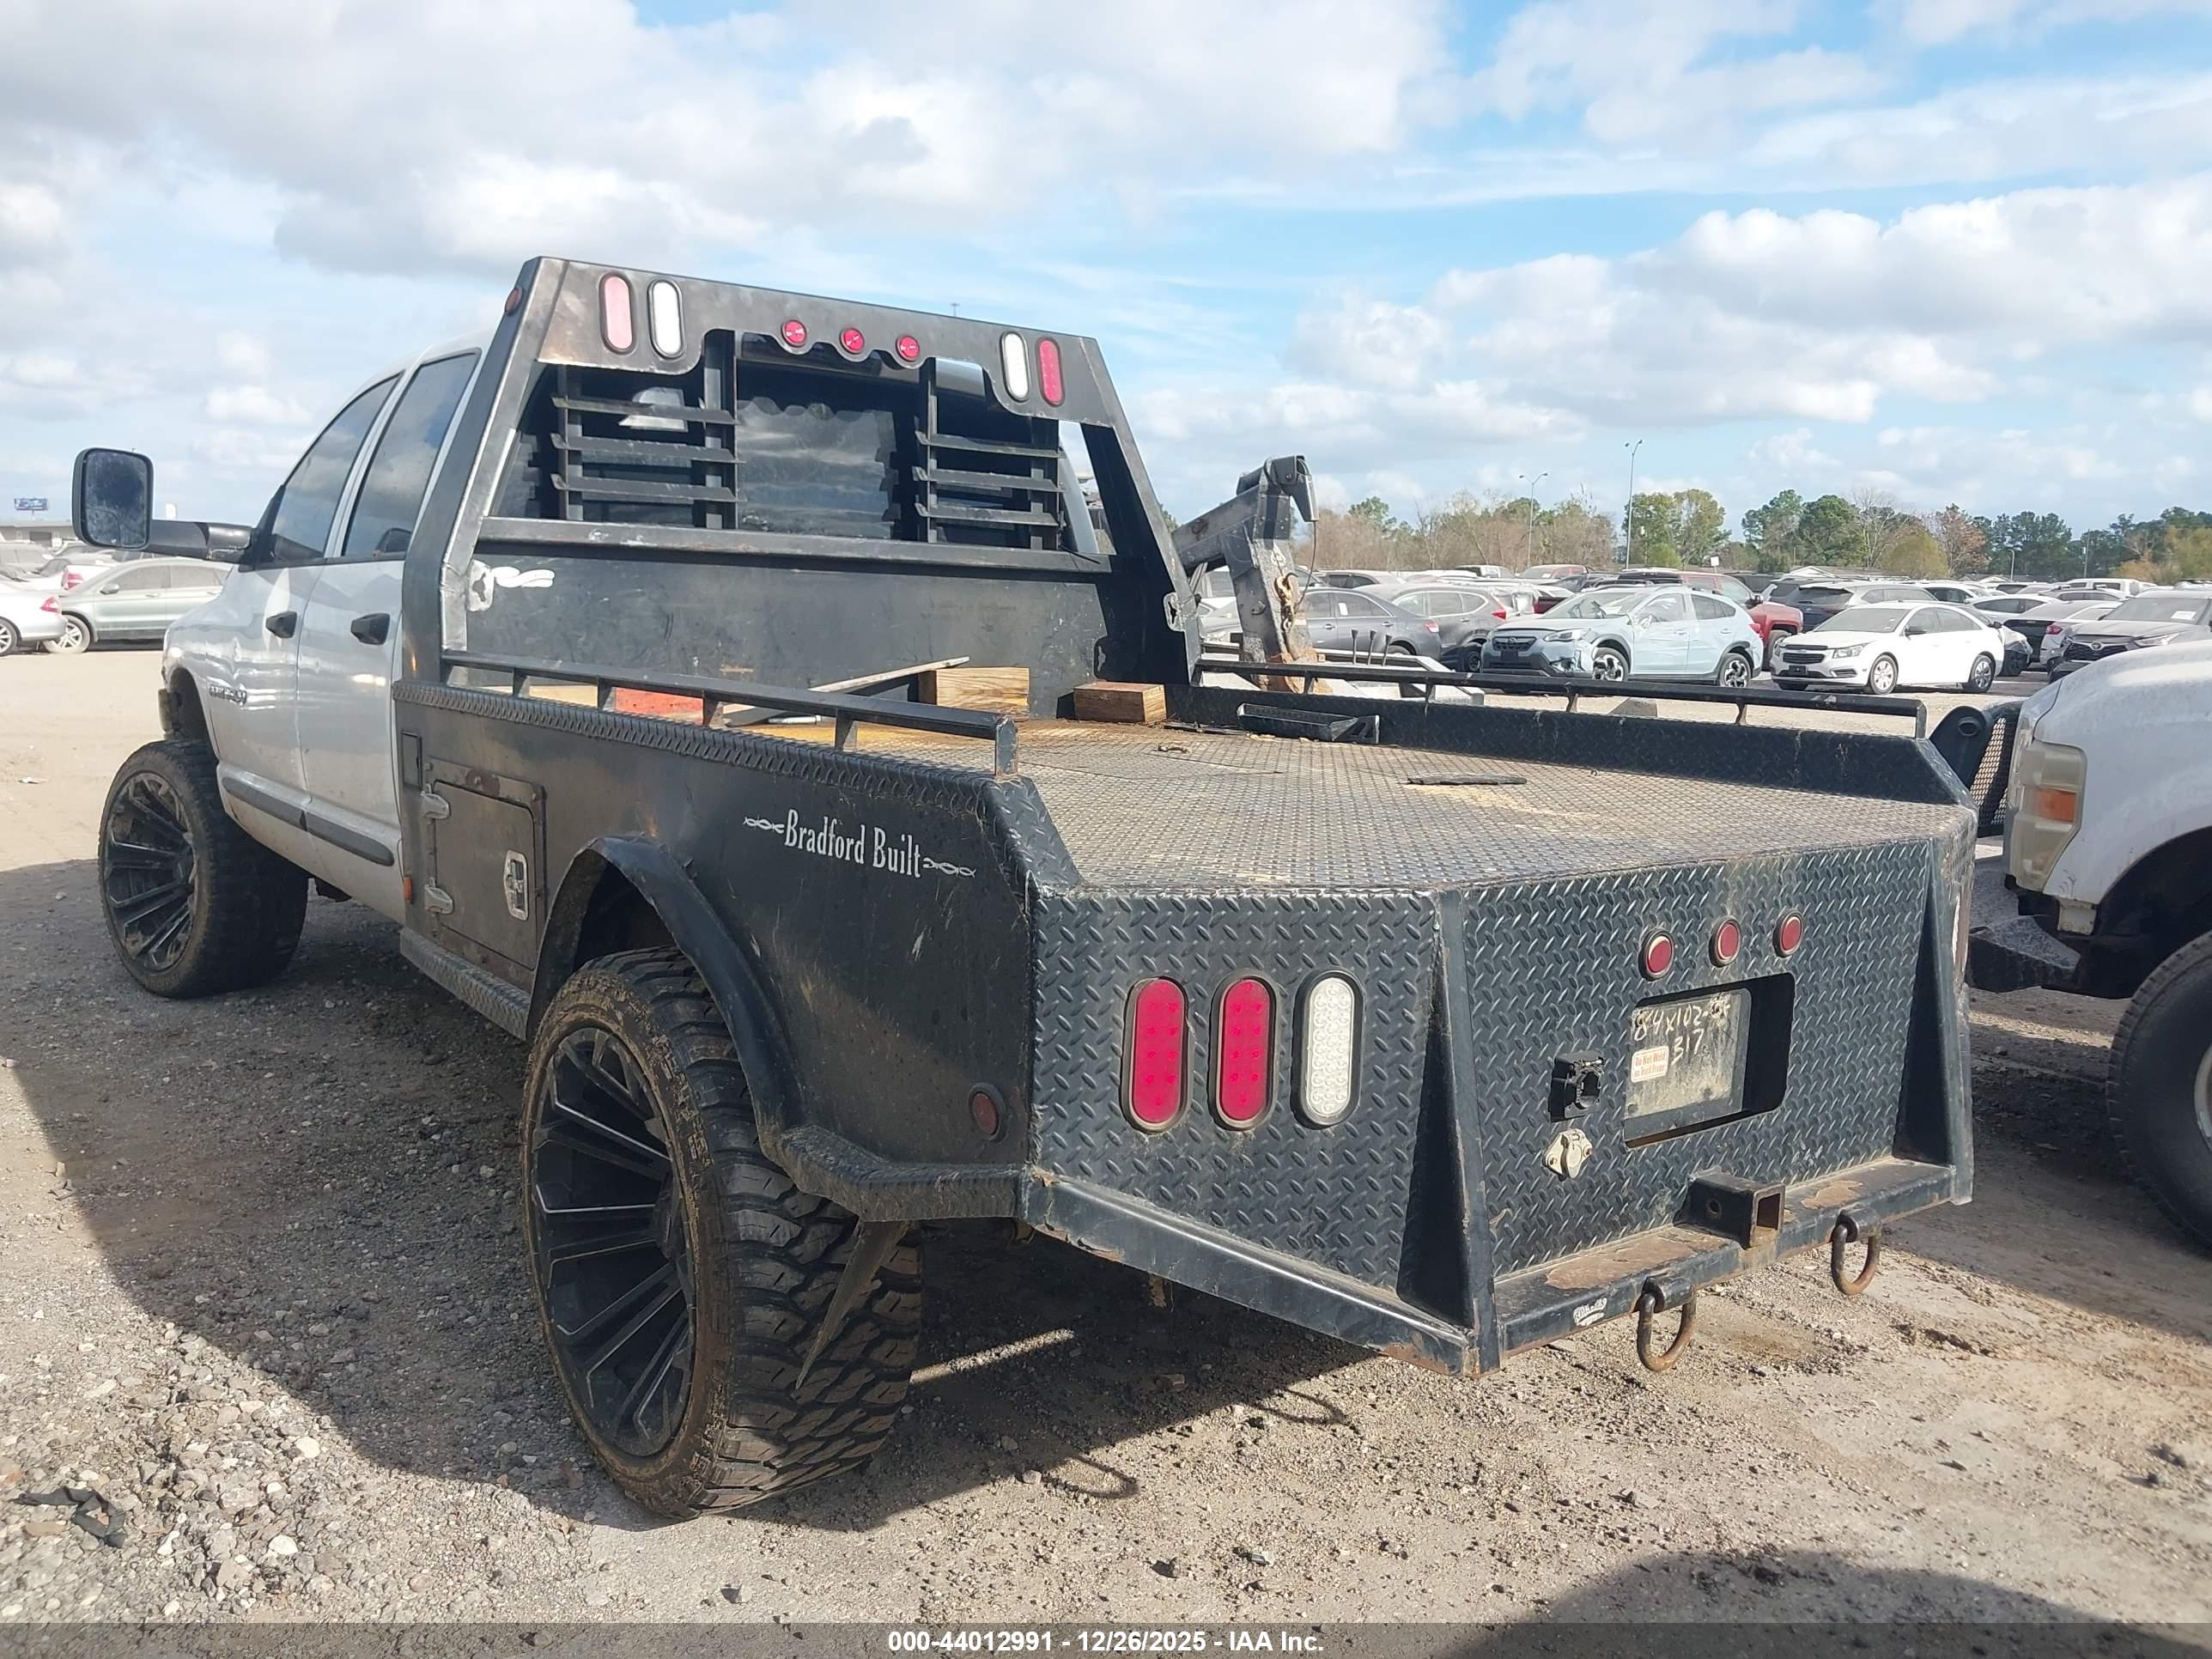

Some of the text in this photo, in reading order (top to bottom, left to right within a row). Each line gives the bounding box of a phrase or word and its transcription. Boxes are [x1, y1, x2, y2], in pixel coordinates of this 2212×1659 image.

[784, 809, 921, 878] Bradford Built
[1671, 1029, 1704, 1065] 317
